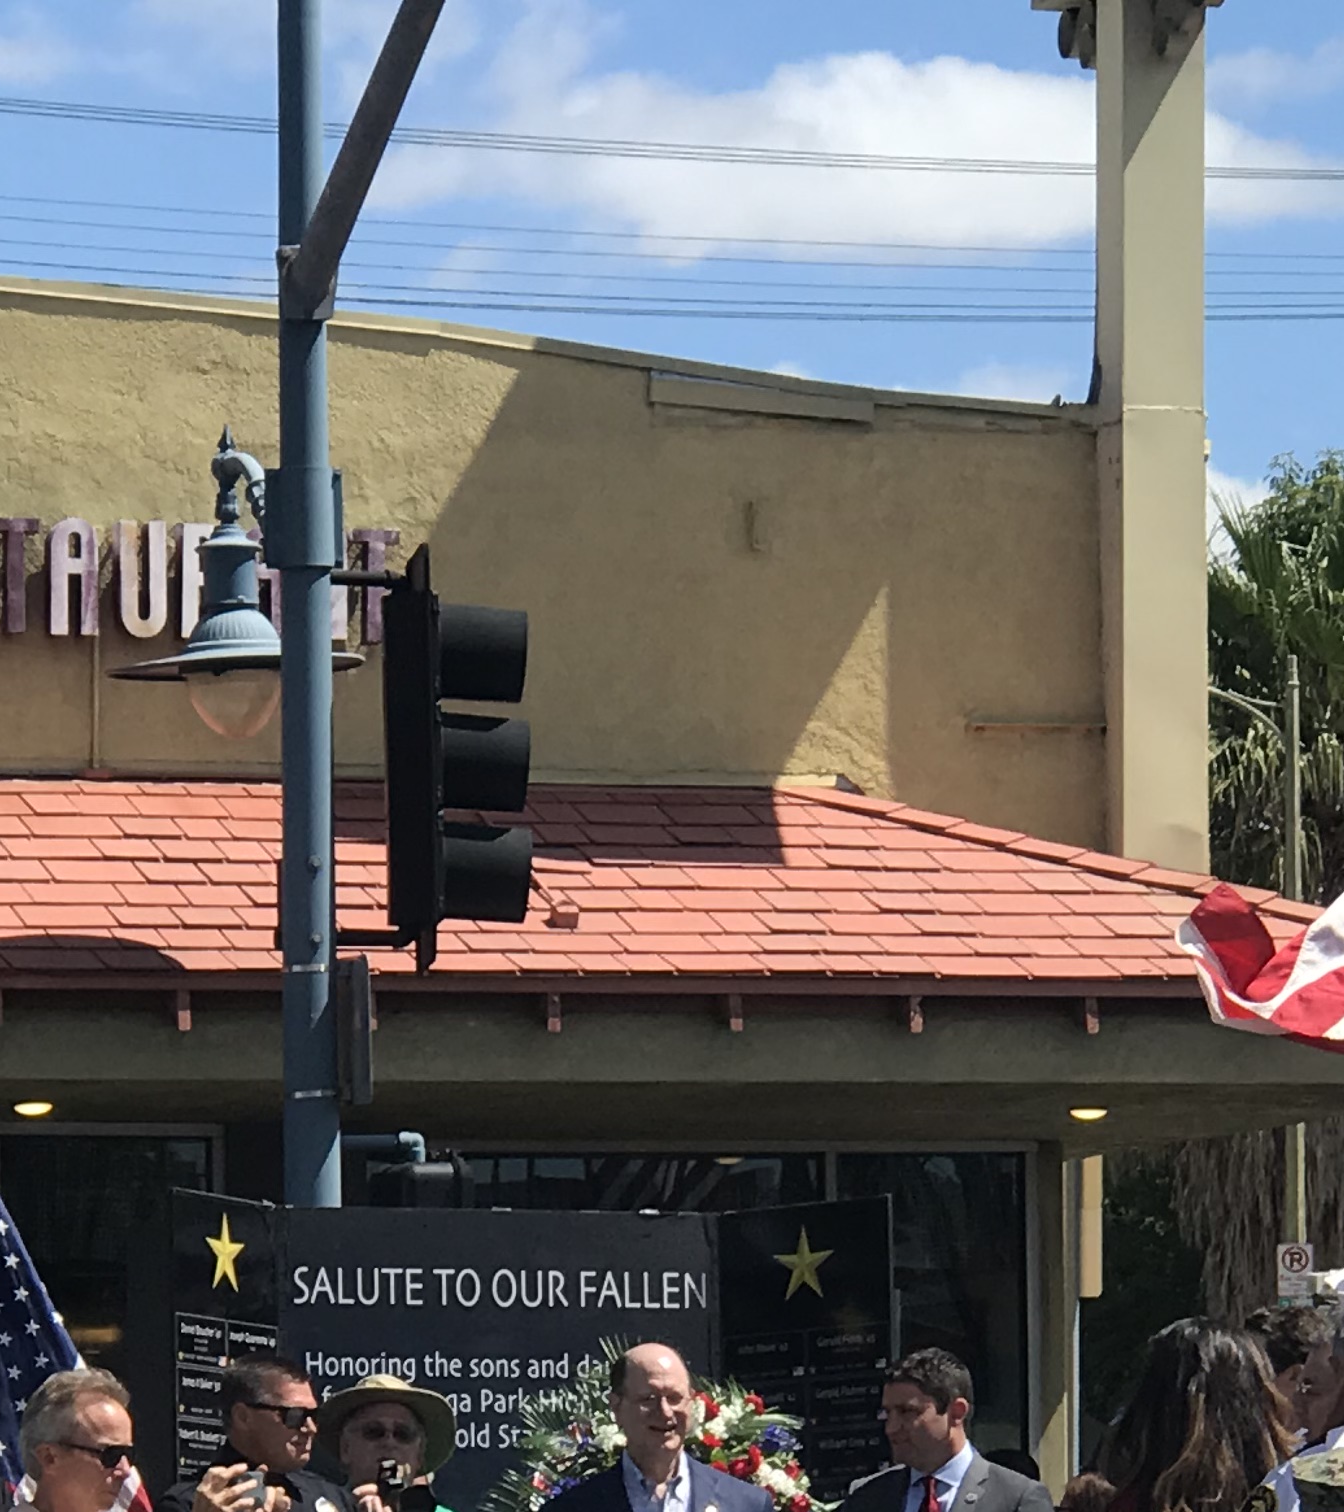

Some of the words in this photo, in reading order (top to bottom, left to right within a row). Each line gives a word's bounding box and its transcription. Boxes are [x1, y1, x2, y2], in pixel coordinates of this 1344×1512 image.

[293, 1266, 423, 1305] SALUTE
[432, 1268, 481, 1307] TO
[492, 1268, 569, 1308] OUR
[580, 1270, 706, 1309] FALLEN
[305, 1351, 416, 1384] Honoring
[423, 1351, 463, 1378] the
[469, 1358, 520, 1379] sons
[527, 1352, 569, 1379] and
[480, 1387, 530, 1414] Park
[455, 1422, 491, 1449] old
